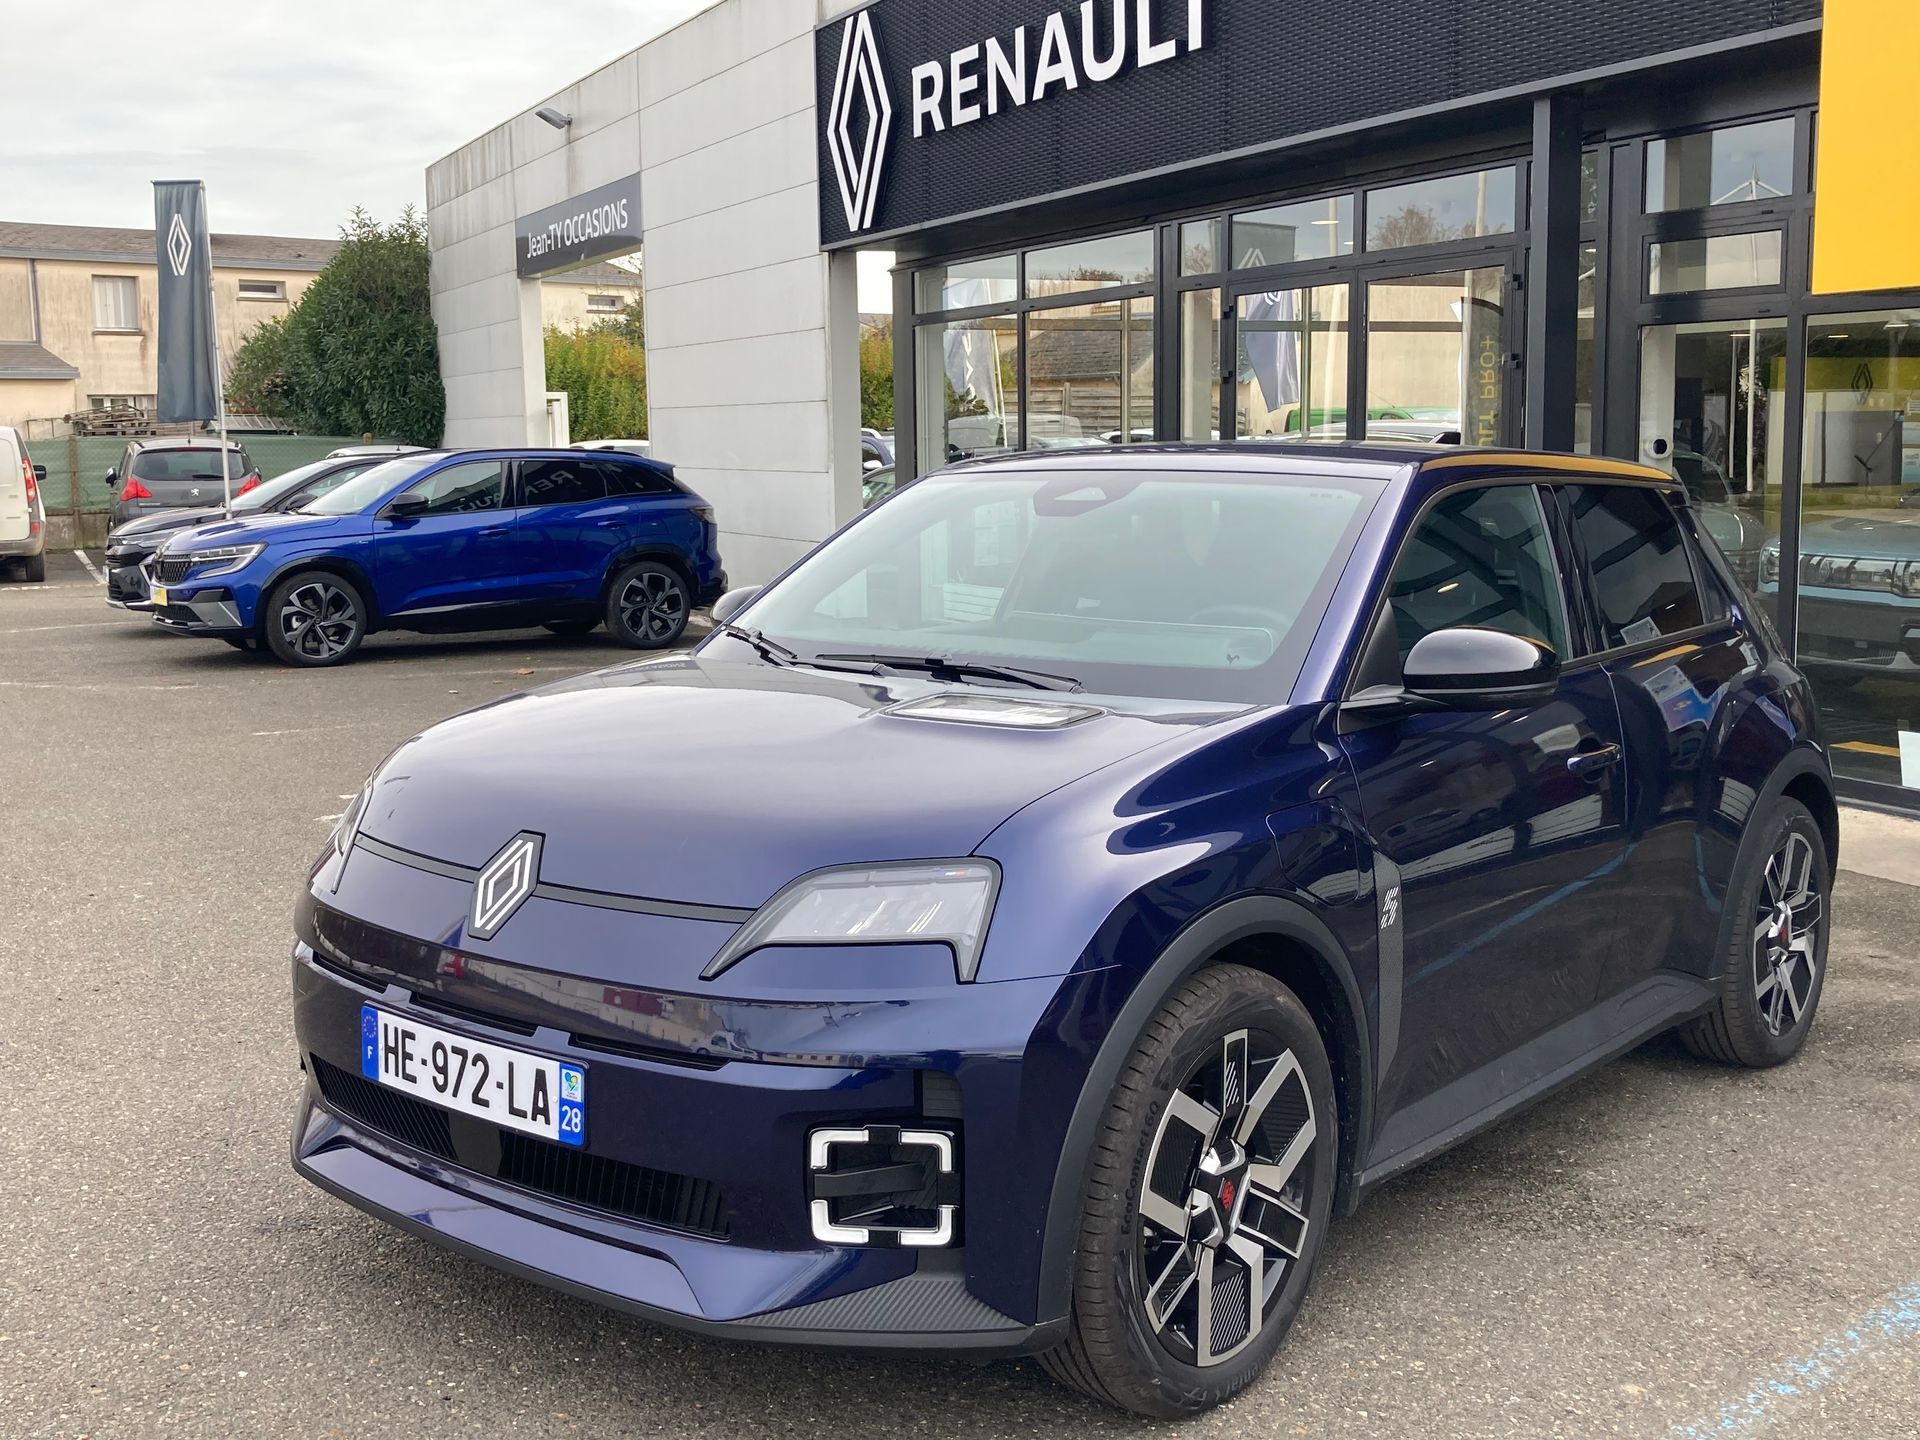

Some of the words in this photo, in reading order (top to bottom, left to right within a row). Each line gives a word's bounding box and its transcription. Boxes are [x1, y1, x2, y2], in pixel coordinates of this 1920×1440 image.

[527, 221, 562, 259] Jean-TY
[563, 198, 628, 247] OCCASIONS
[367, 1045, 374, 1060] F
[383, 1022, 552, 1126] HE-972-LA
[561, 1105, 582, 1134] 28
